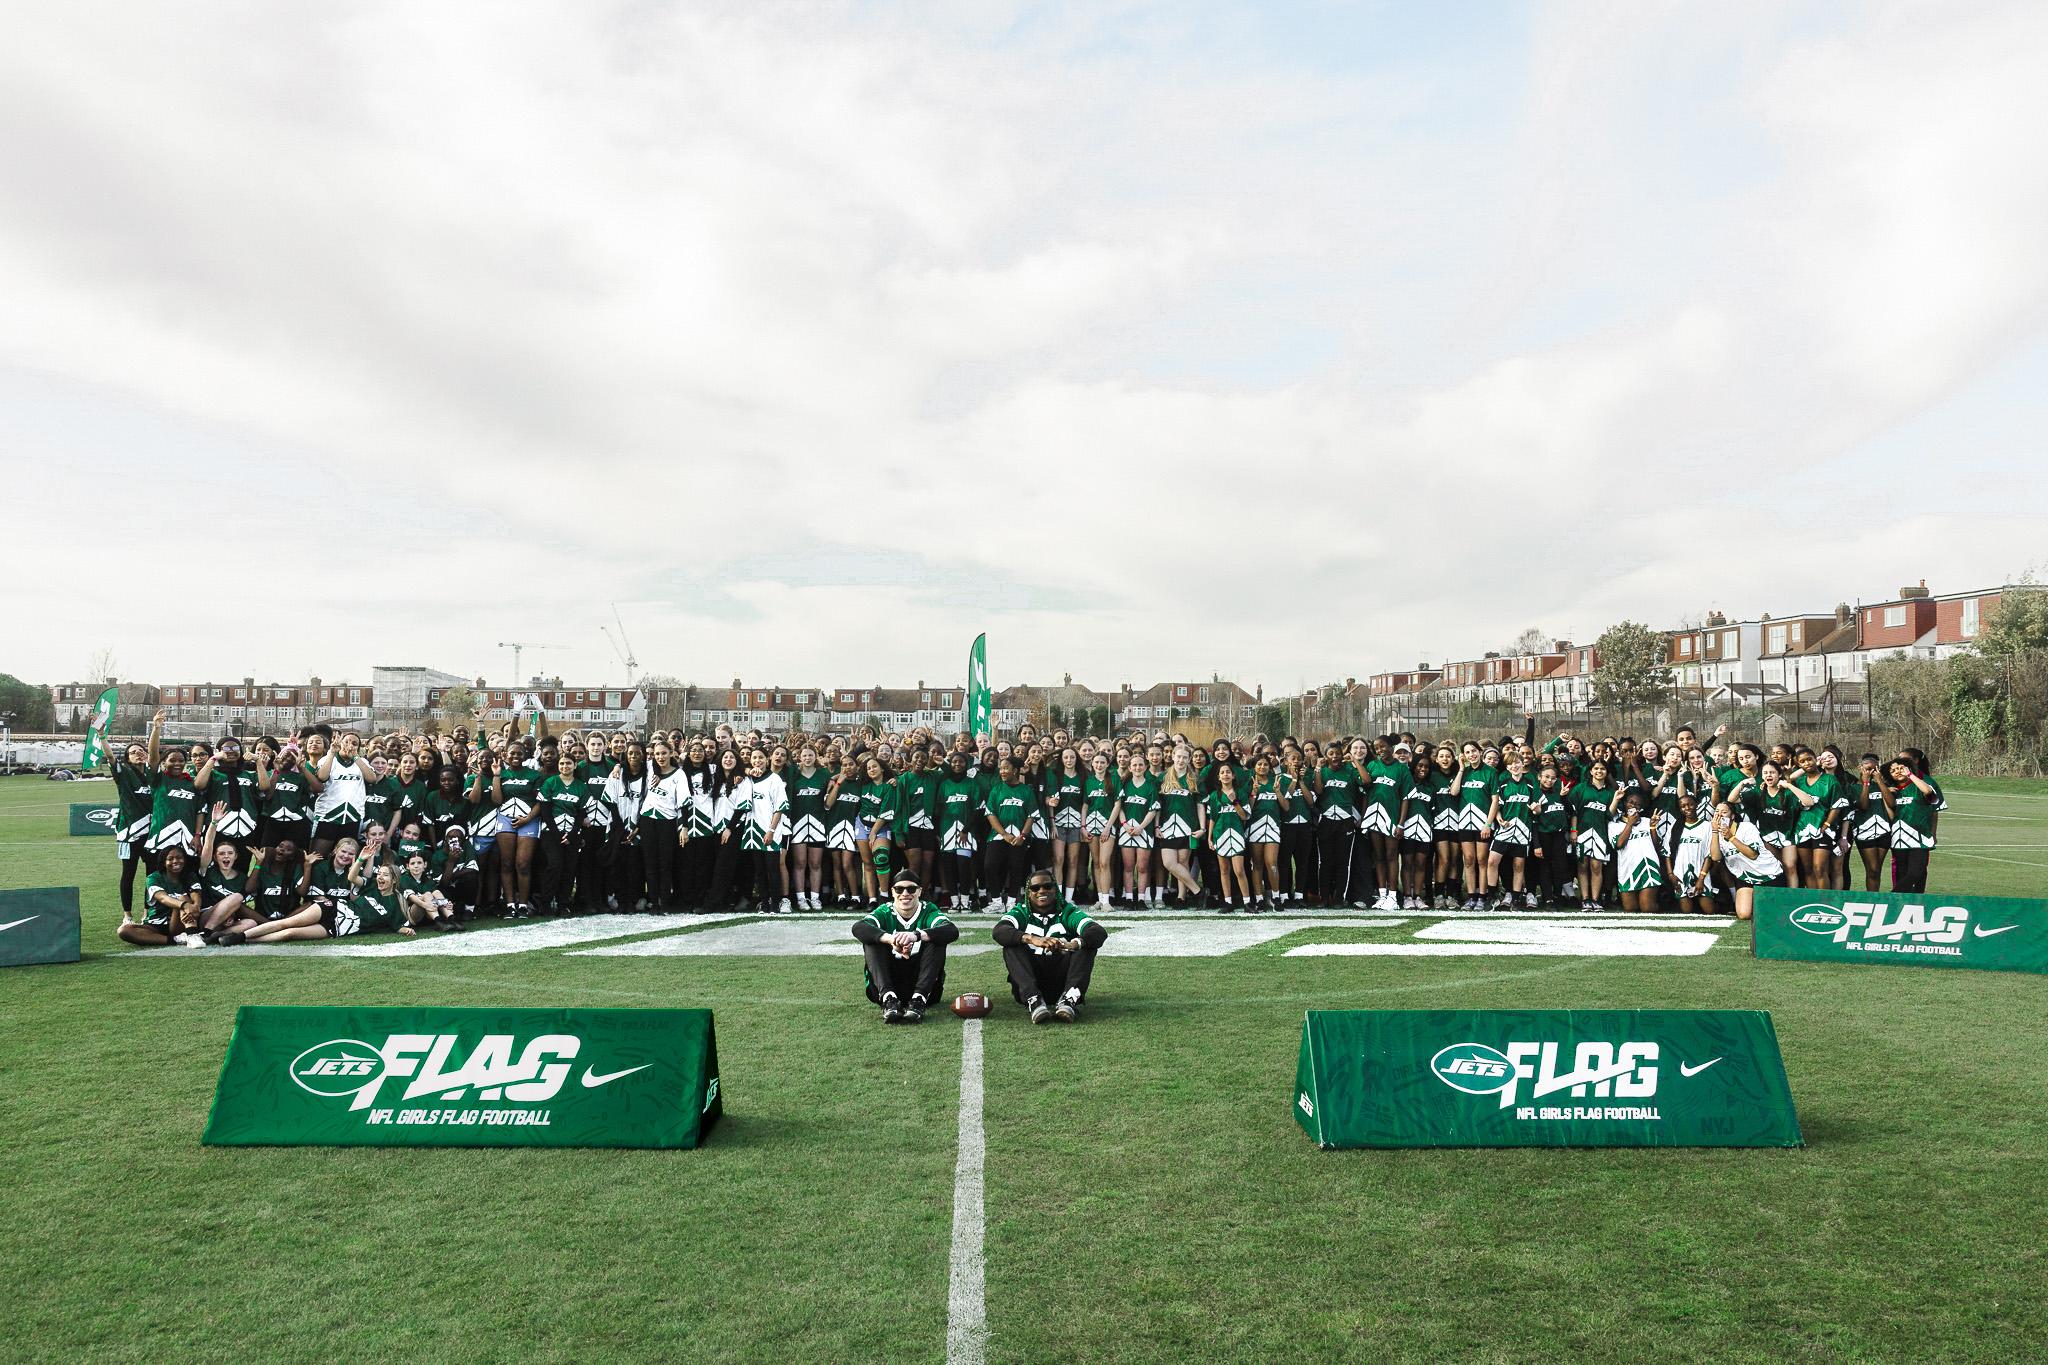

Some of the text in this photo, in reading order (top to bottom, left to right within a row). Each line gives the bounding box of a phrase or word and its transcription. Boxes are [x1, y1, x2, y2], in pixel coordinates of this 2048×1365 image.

[1325, 779, 1348, 788] JETS
[1373, 775, 1397, 786] JETS
[1461, 779, 1485, 788] JETS
[168, 788, 195, 799] JETS
[797, 787, 820, 796] JETS
[1000, 797, 1024, 806] JETS
[1506, 793, 1530, 802] JETS
[1628, 830, 1650, 840] JETS
[1680, 836, 1702, 844] JETS
[326, 887, 350, 896] JETS
[1796, 902, 1969, 943] JETS FLAG
[1846, 942, 1962, 956] NFL GIRLS FLAG FOOTBALL
[299, 1034, 581, 1112] JETS FLAG
[1440, 1042, 1659, 1109] JETS FLAG
[1298, 1091, 1314, 1118] JETS
[366, 1109, 550, 1125] NFL GIRLS FLAG FOOTBALL
[1516, 1107, 1661, 1120] NFL GIRLS FLAG FOOTBALL
[1701, 1117, 1735, 1136] NYJ
